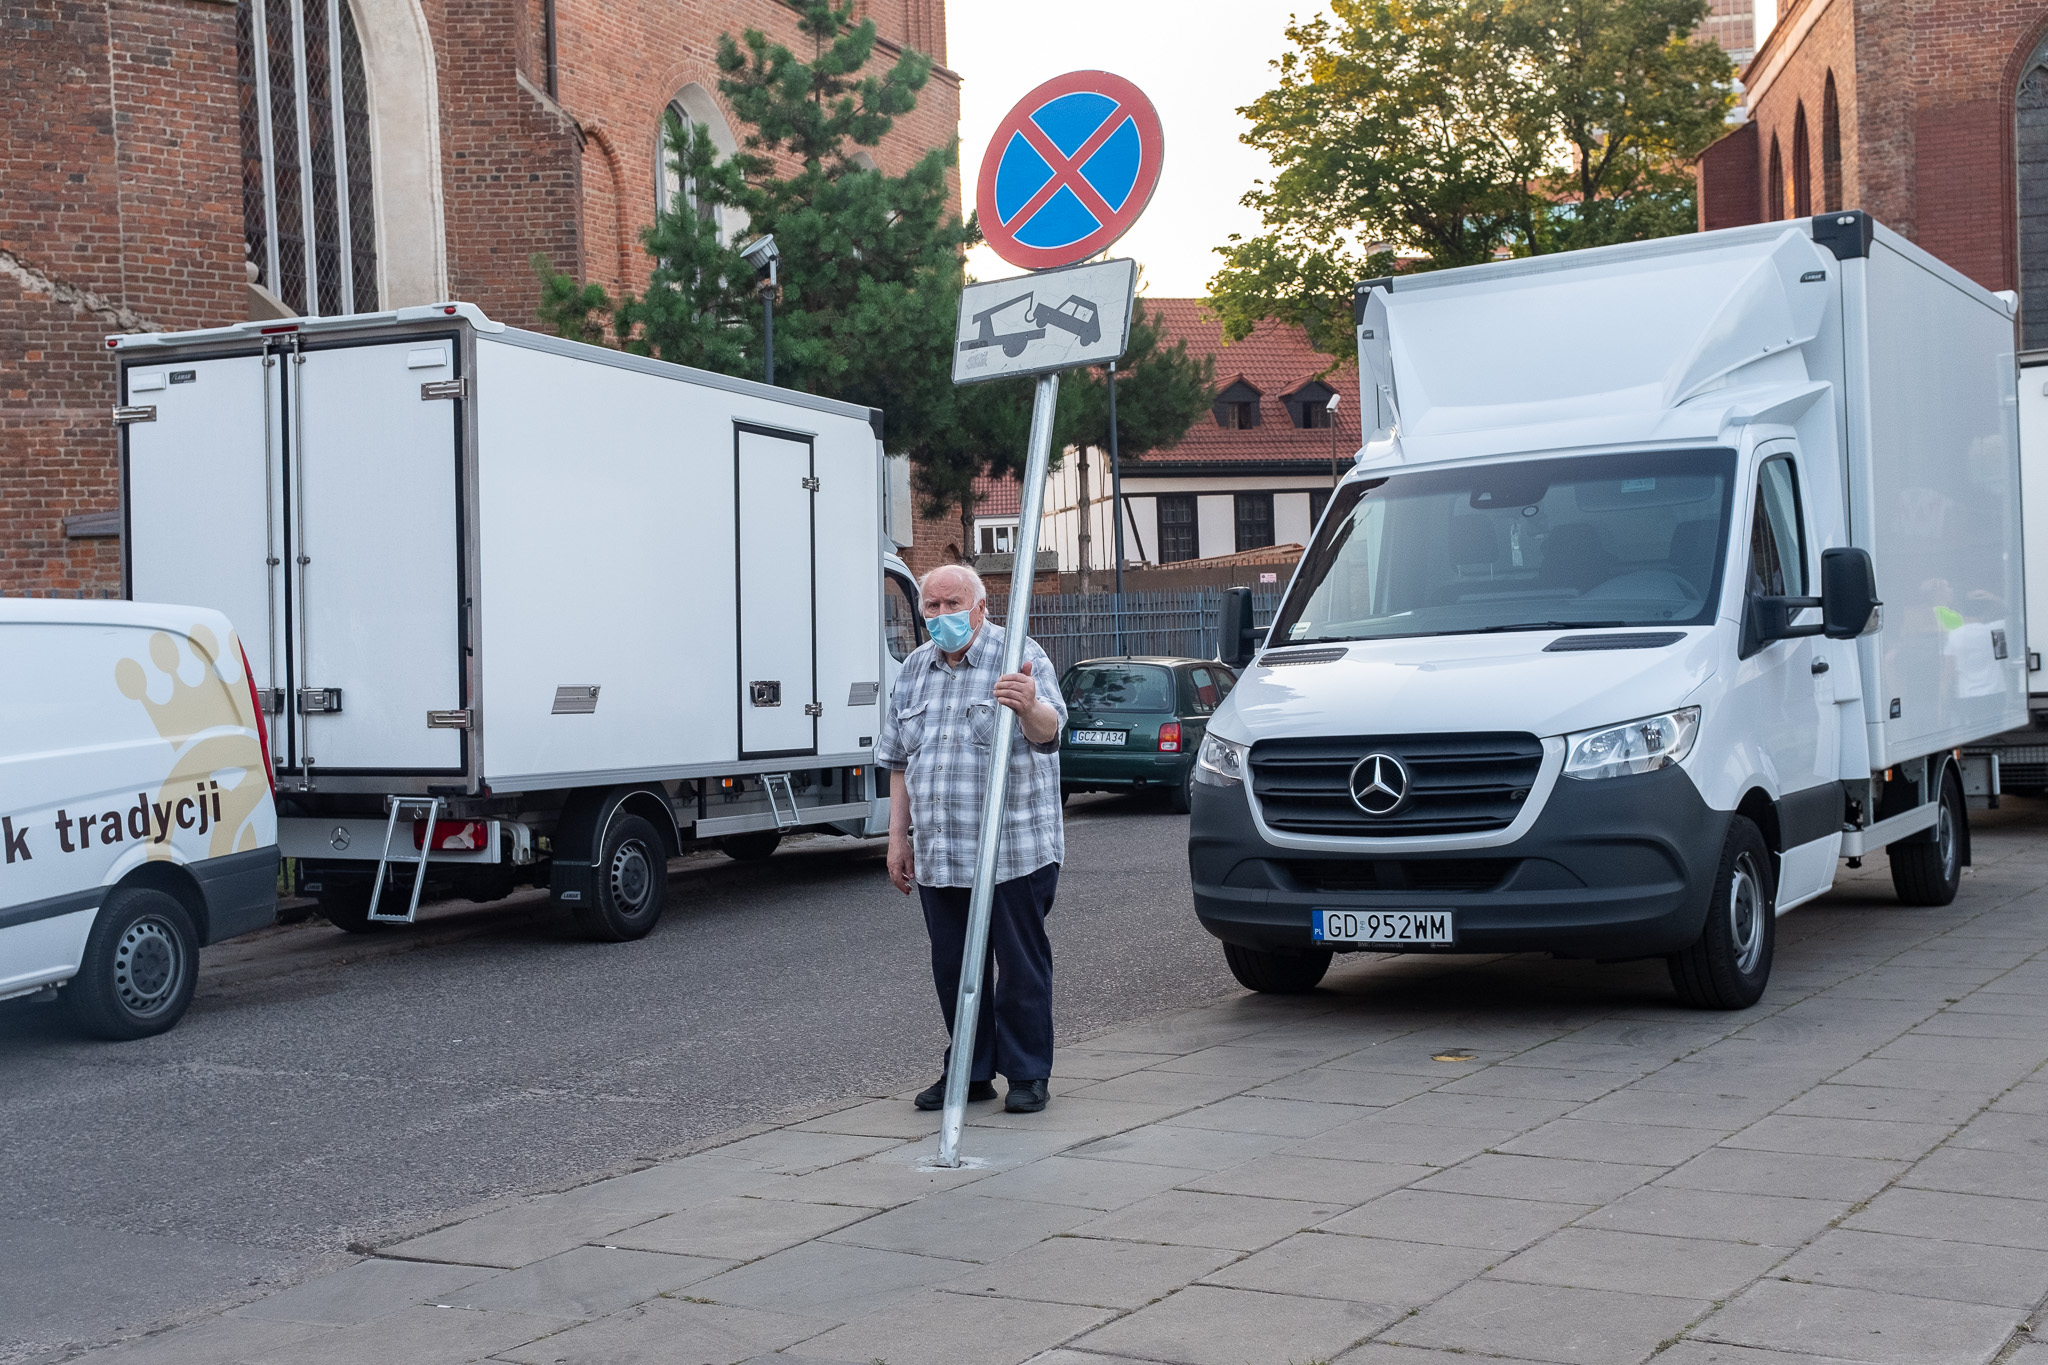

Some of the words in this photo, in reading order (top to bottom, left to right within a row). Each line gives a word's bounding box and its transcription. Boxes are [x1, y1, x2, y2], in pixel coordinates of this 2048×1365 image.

[1078, 731, 1097, 742] GCZ
[1100, 731, 1125, 743] TA34
[55, 780, 222, 853] tradycji
[1328, 913, 1358, 938] GD
[1367, 914, 1445, 940] 952WM
